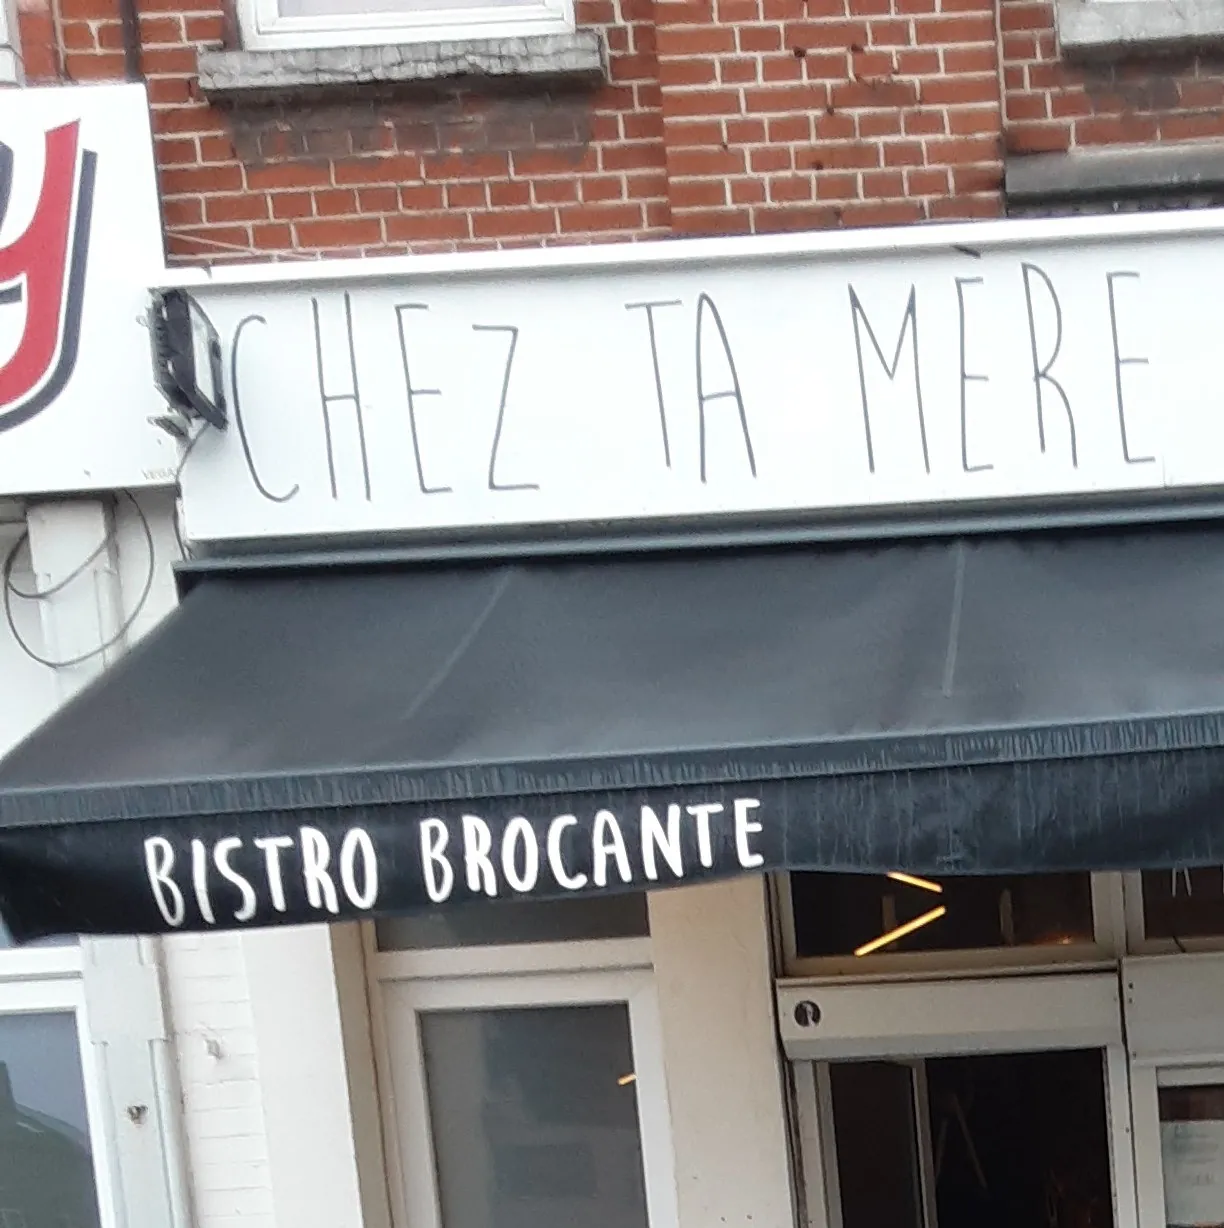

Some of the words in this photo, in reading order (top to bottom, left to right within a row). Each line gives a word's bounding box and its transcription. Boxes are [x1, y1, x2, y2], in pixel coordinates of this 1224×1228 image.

[231, 290, 540, 503] CHEZ
[625, 292, 757, 484] TA
[847, 244, 1157, 474] MÈRE
[143, 826, 379, 929] BISTRO
[420, 797, 765, 903] BROCANTE
